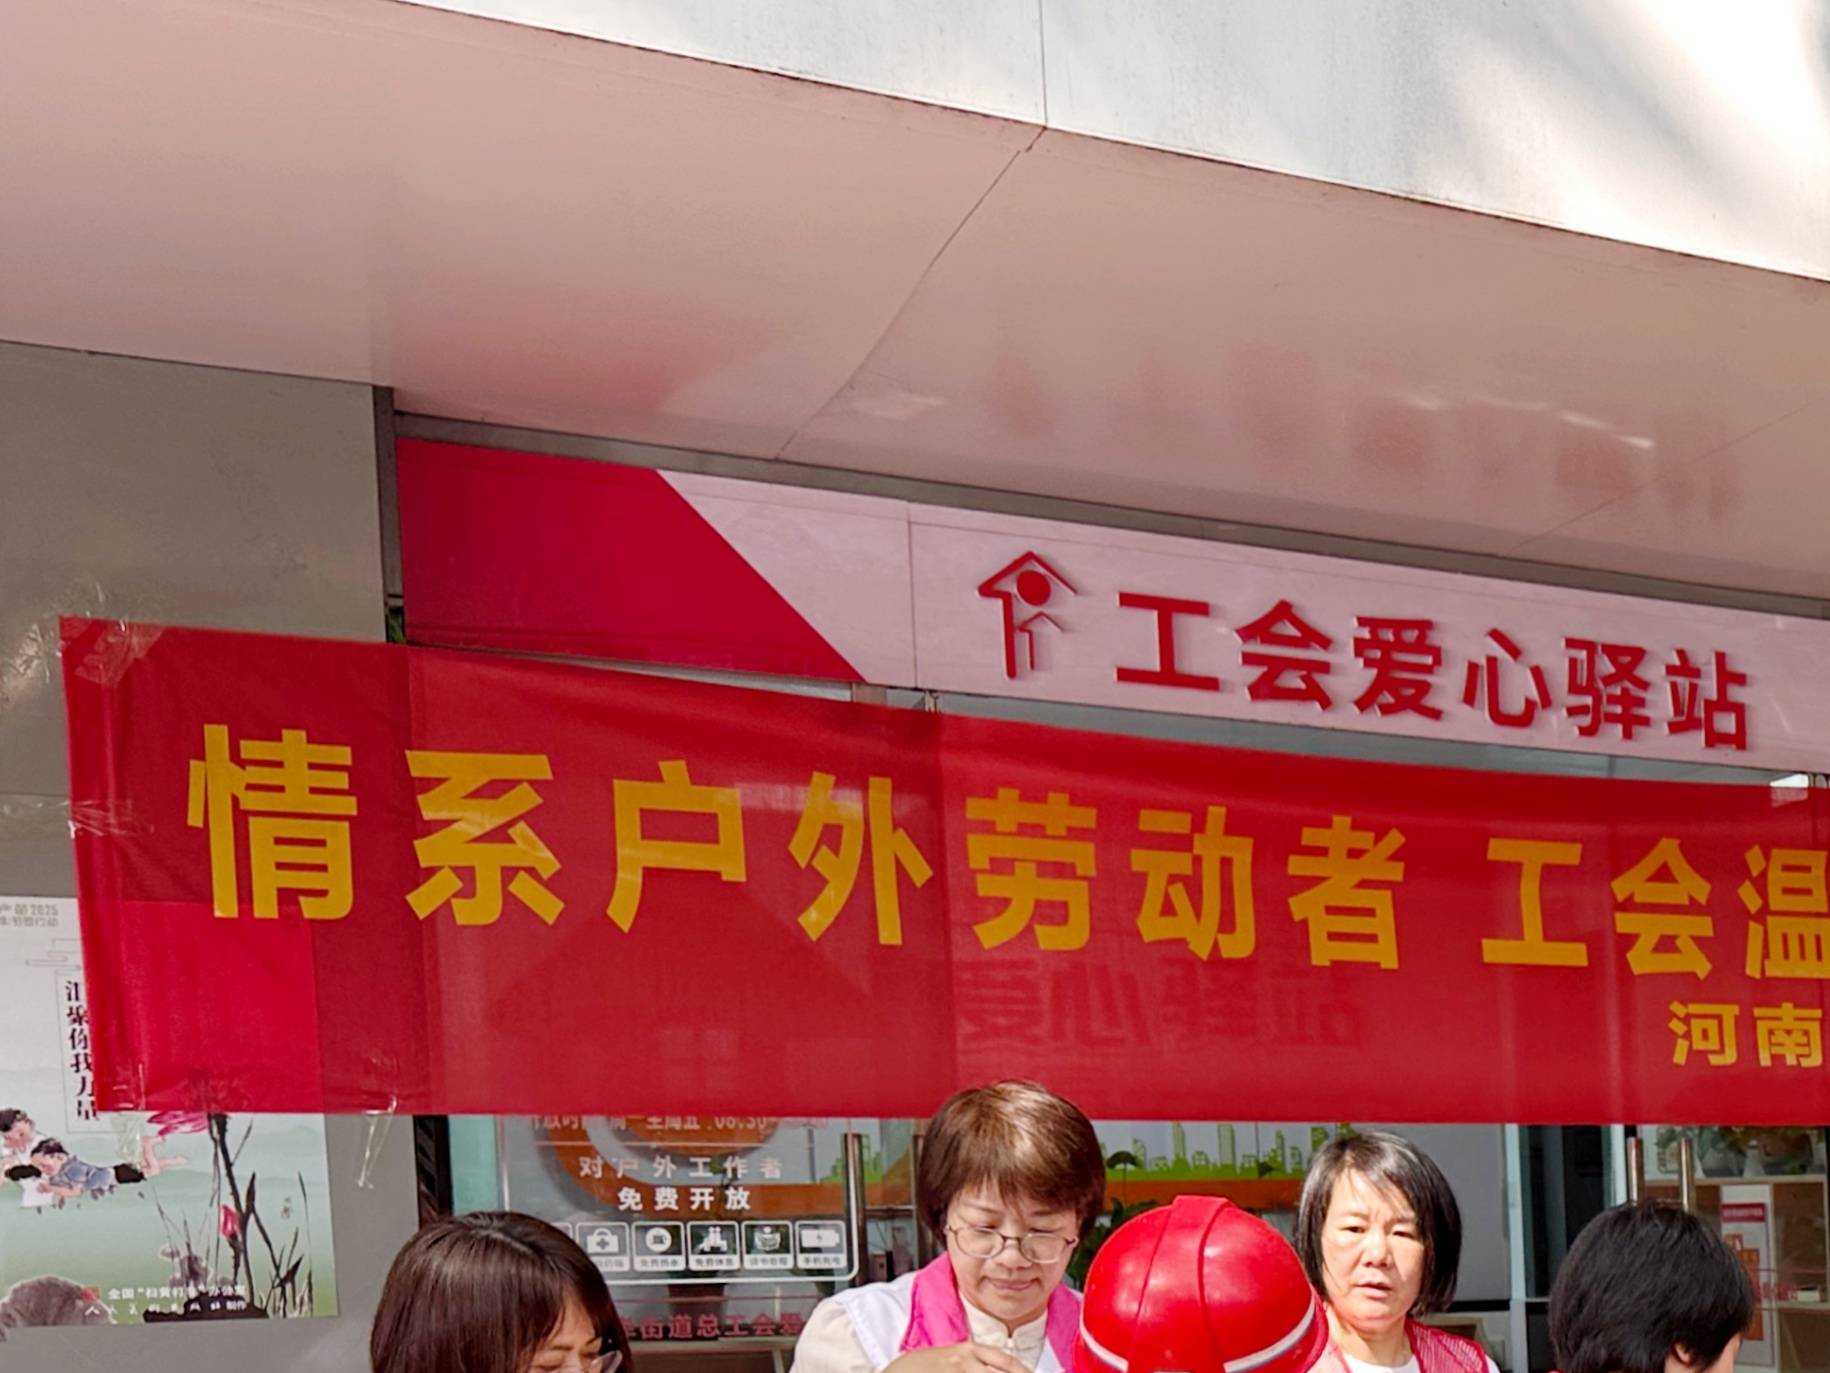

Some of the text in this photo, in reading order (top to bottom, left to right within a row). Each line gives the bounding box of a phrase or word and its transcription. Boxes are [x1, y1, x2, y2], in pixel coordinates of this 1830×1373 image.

[1116, 591, 1755, 752] 工会爱心驿站
[187, 723, 1406, 970] 情系户外劳动者
[579, 1155, 783, 1179] 对户外工作者
[618, 1186, 751, 1211] 免费开放
